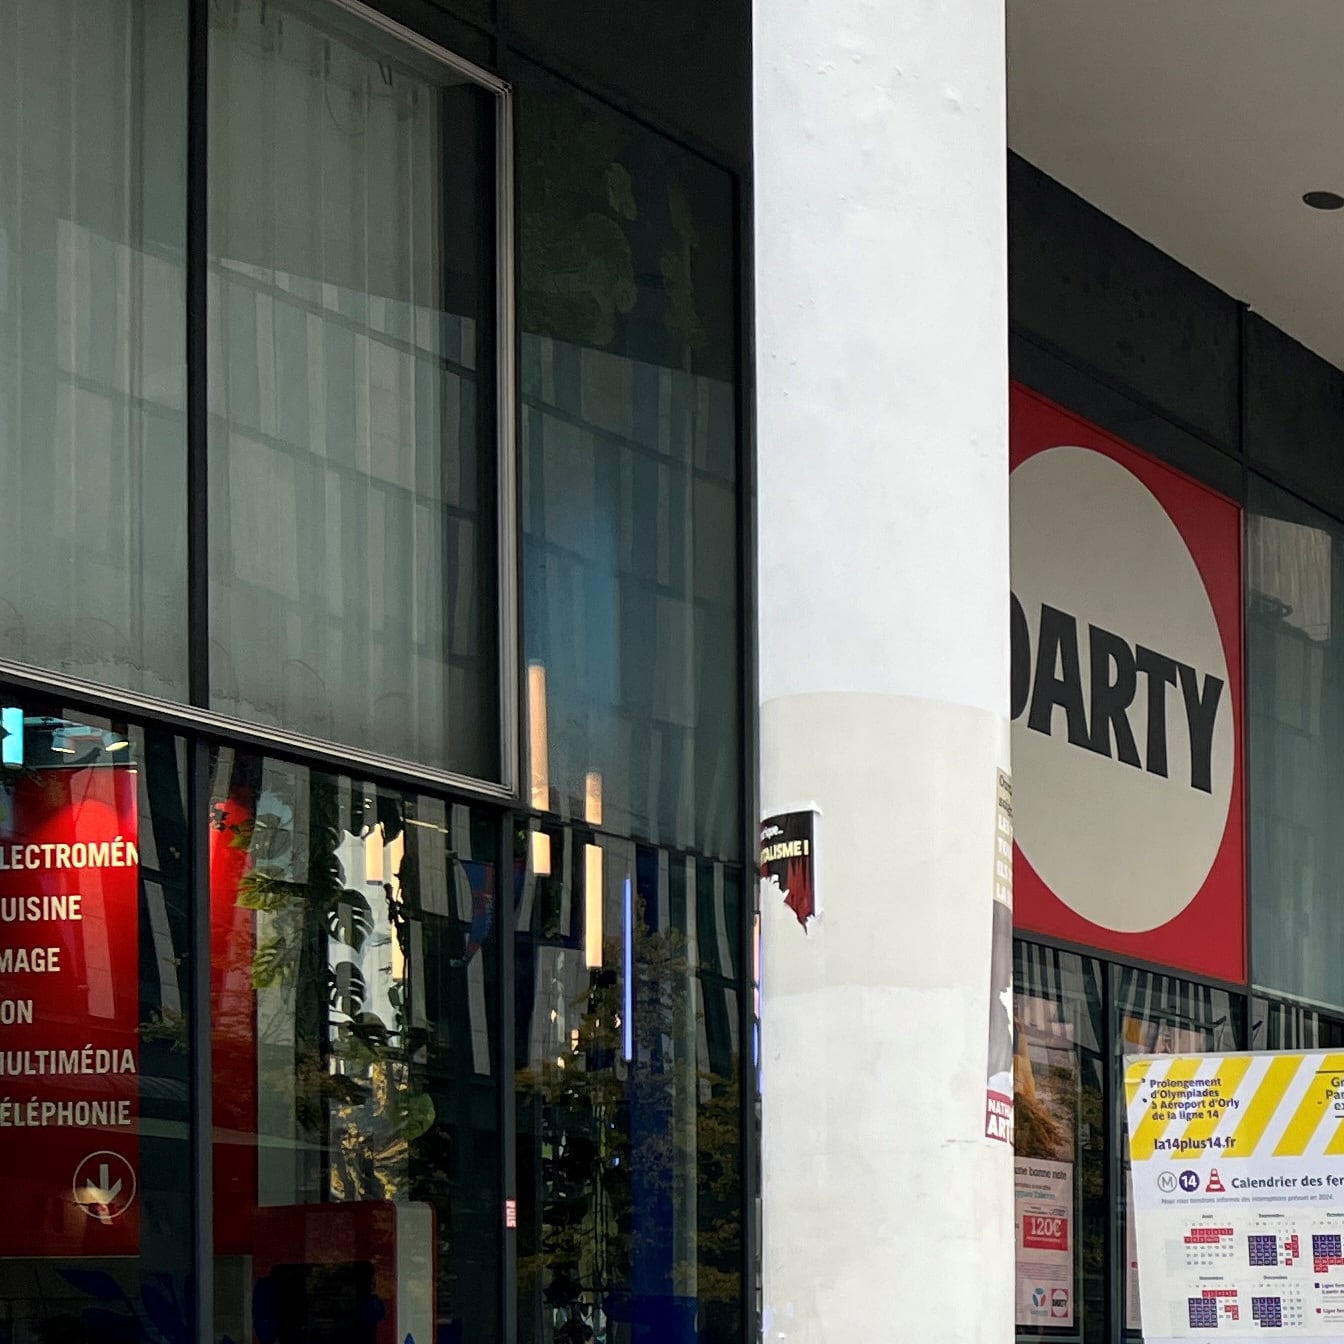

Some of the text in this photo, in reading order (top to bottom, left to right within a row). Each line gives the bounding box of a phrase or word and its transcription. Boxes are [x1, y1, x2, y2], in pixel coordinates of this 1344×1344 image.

[1, 1000, 33, 1025] ON
[1150, 1078, 1222, 1089] Prolongement
[1151, 1089, 1220, 1100] d'Olympiades
[1152, 1098, 1240, 1110] à Aéroport d'Orly
[1152, 1110, 1219, 1121] de la ligne 14
[1154, 1137, 1236, 1152] la14plus14.fr
[1181, 1175, 1198, 1188] 14
[1231, 1175, 1297, 1189] Calendrier
[1301, 1175, 1323, 1187] des
[1032, 1217, 1063, 1238] 120€
